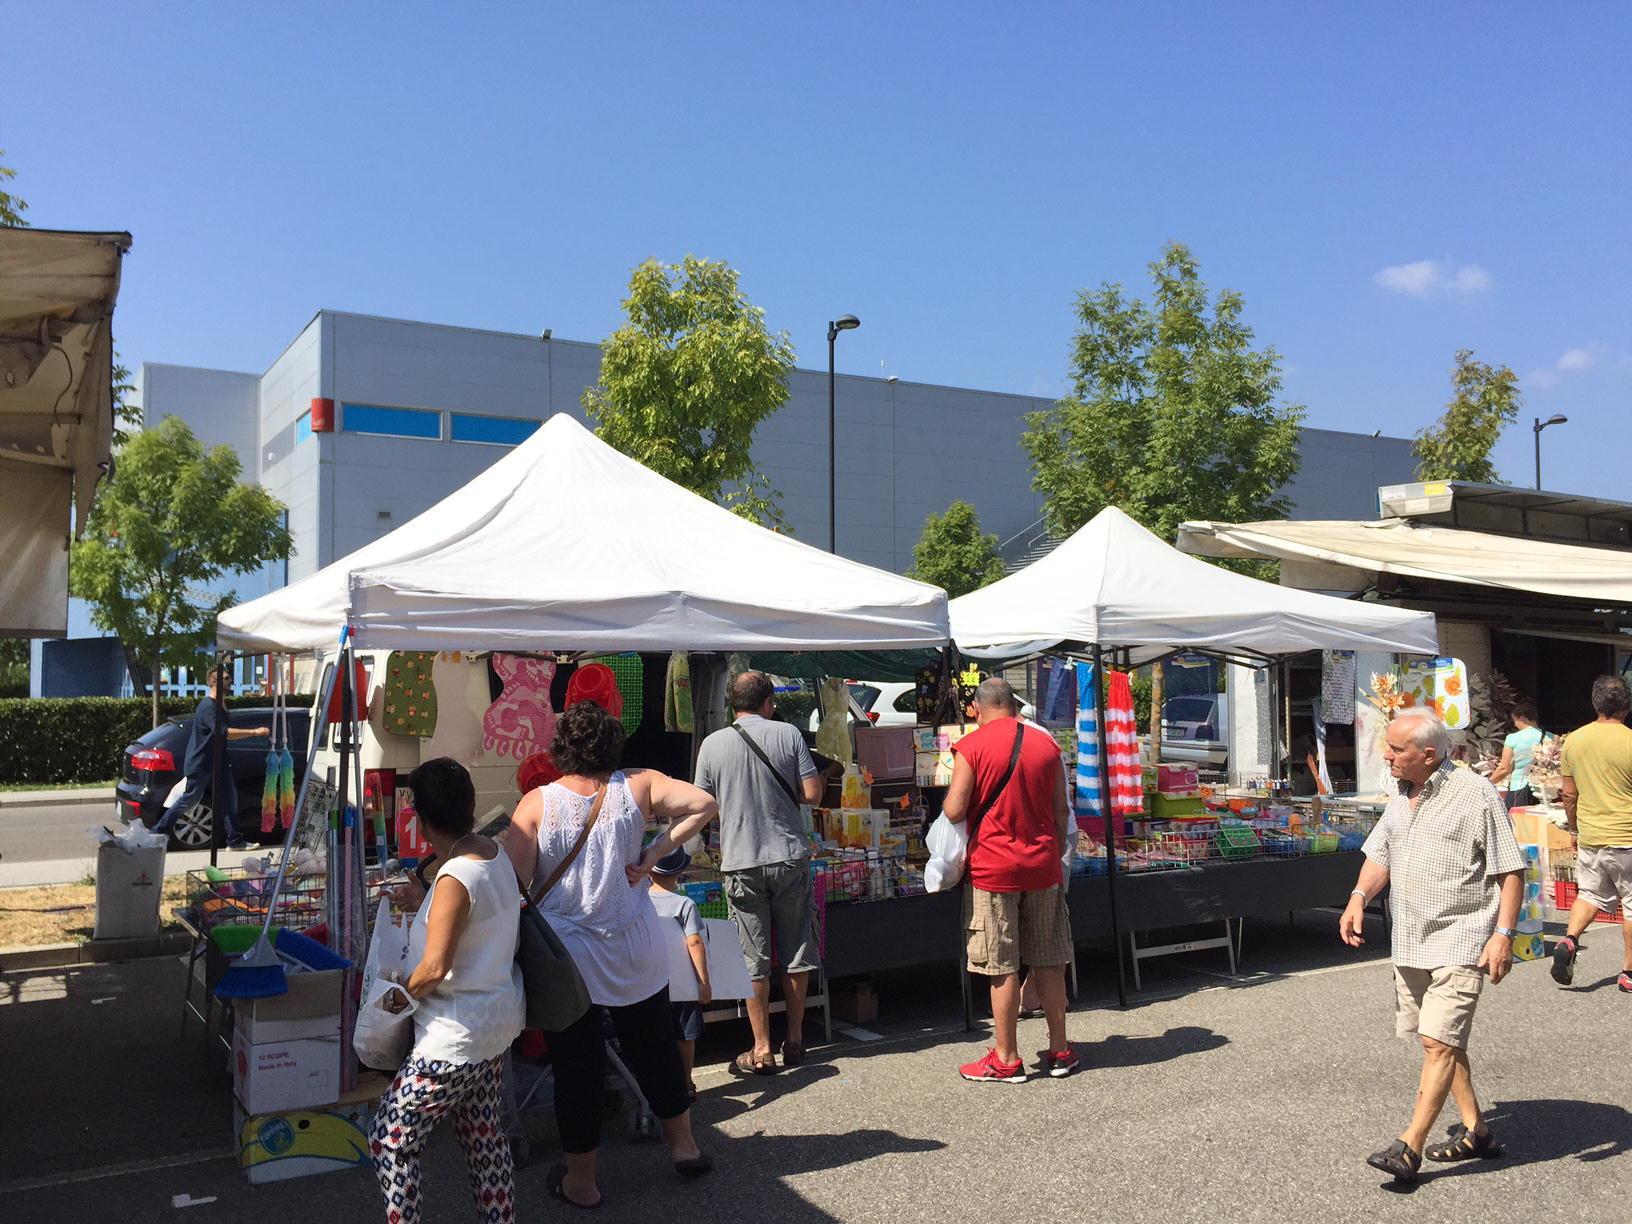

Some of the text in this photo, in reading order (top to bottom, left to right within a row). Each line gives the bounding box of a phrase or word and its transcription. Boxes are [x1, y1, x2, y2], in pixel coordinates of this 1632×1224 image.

[266, 1052, 289, 1060] SCOPE
[258, 1063, 275, 1071] Made
[284, 1060, 297, 1068] Italy
